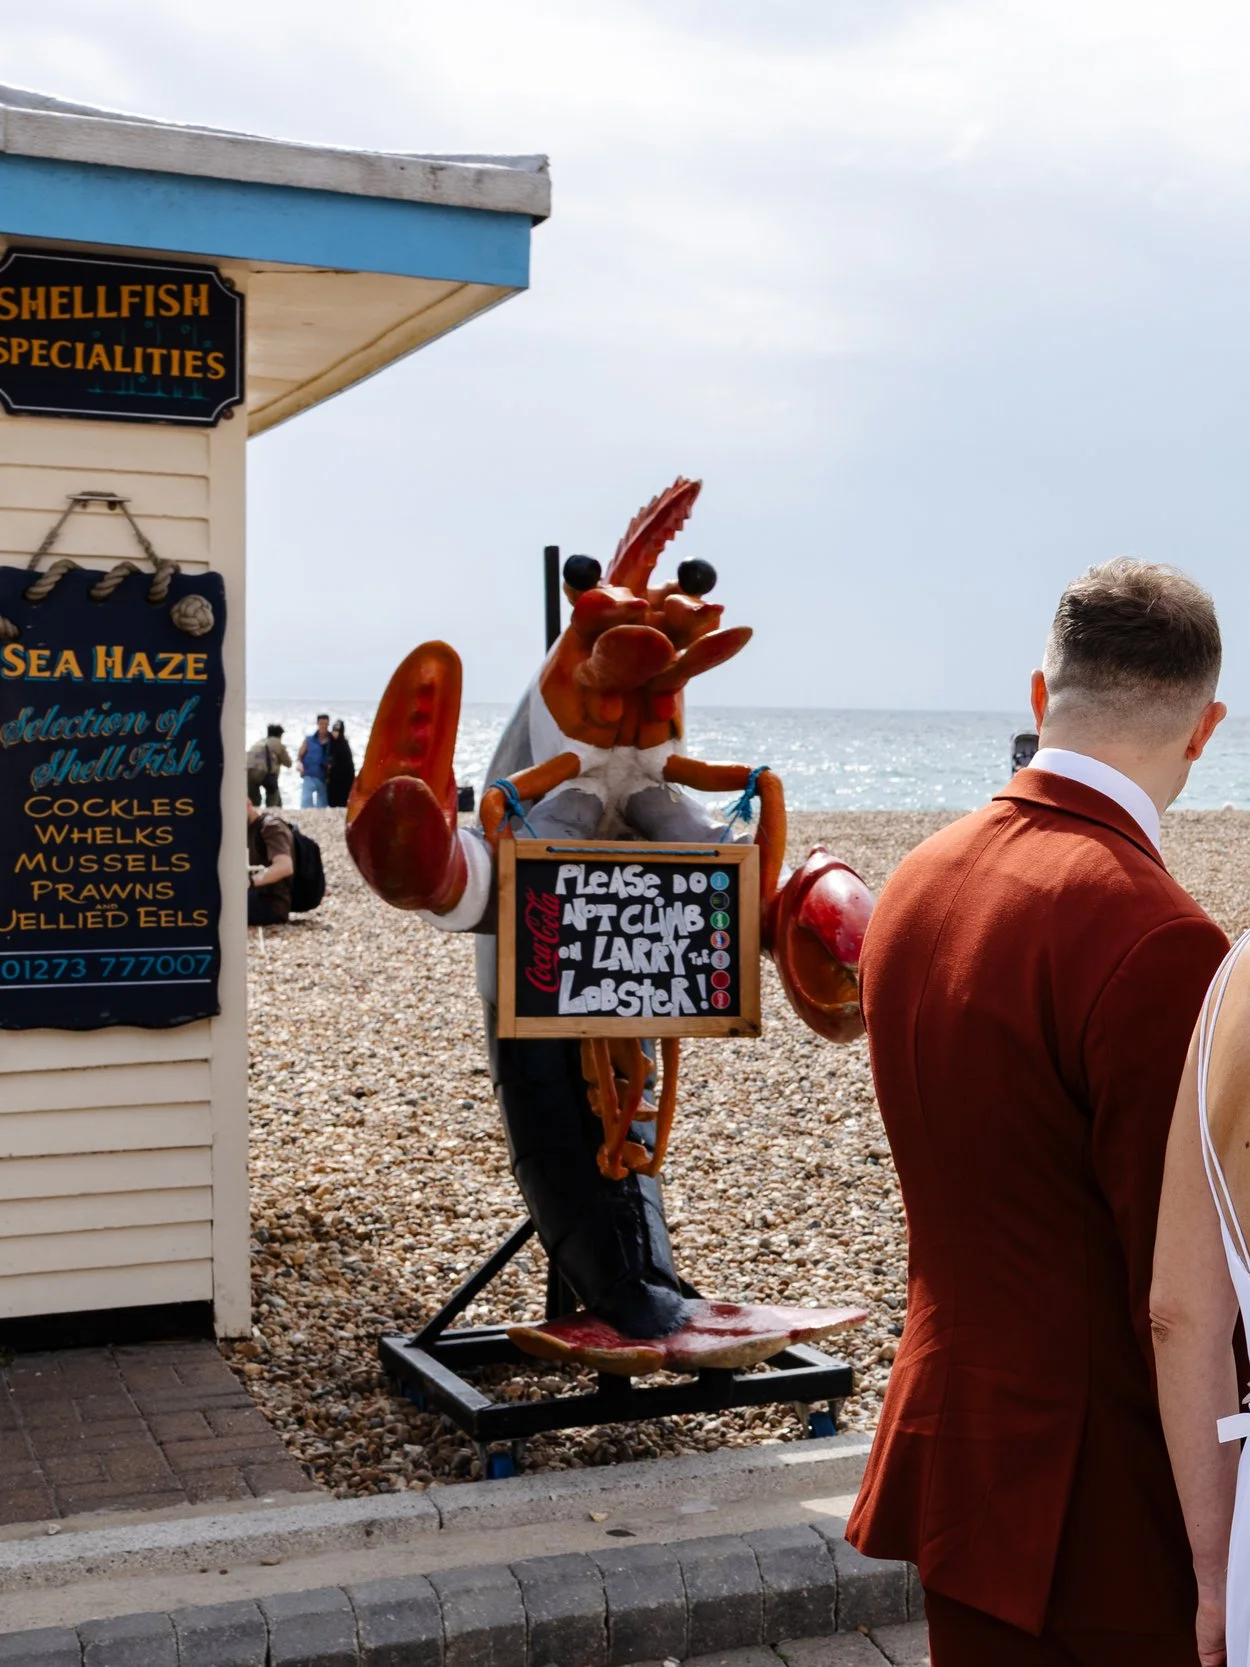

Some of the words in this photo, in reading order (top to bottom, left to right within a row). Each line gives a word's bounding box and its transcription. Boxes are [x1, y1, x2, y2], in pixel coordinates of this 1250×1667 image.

[0, 284, 209, 320] SHELLFISH
[1, 643, 83, 682] SEA
[92, 645, 208, 684] HAZE
[0, 702, 149, 749] Selection
[156, 695, 200, 740] of
[30, 747, 124, 792] Shell
[123, 740, 204, 781] Fish
[24, 796, 195, 819] COCKLES
[34, 824, 174, 847] WHELKS
[14, 852, 191, 874] MUSSELS
[30, 880, 175, 904] PRAWNS
[672, 872, 708, 894] DO
[0, 909, 129, 932] JELLIED
[136, 906, 209, 928] EELS
[1, 958, 87, 980] 01273
[100, 954, 212, 978] 777007
[592, 936, 691, 975] LARRY
